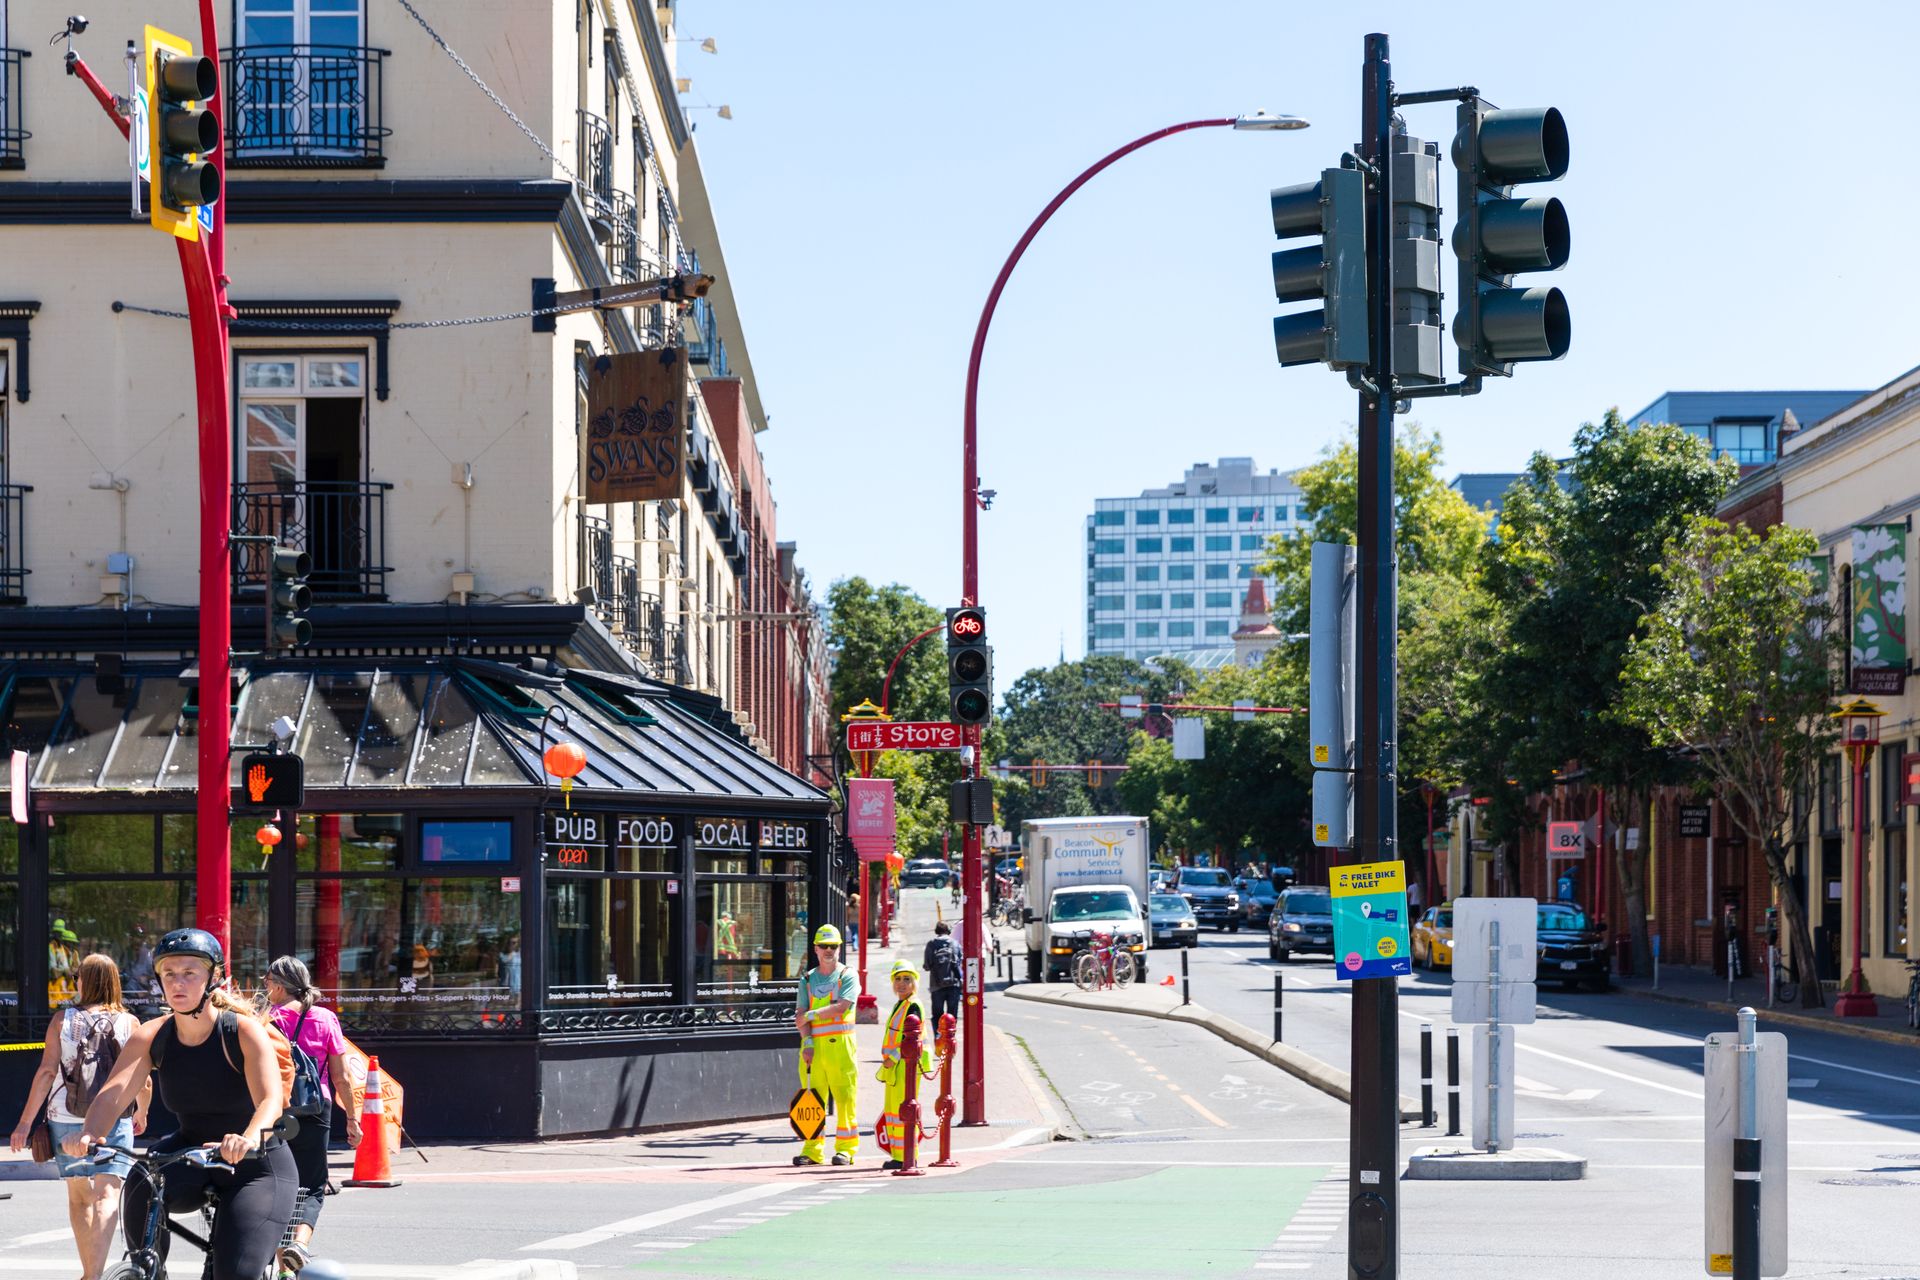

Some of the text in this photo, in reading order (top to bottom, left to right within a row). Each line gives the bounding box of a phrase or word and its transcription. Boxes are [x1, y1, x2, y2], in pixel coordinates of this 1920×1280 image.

[589, 435, 677, 484] SWANS
[1860, 672, 1898, 680] MARKET
[1857, 682, 1898, 690] SQUARE
[890, 725, 956, 742] Store
[1682, 809, 1707, 817] VINTAGE
[555, 817, 597, 840] PUB
[618, 820, 673, 843] FOOD
[762, 825, 807, 848] BEER
[1064, 839, 1095, 847] Beacon
[1560, 834, 1582, 847] 8X
[558, 848, 588, 868] open
[1087, 859, 1120, 867] Services
[1056, 868, 1123, 877] www.beaconcs.ca
[1351, 870, 1396, 881] FREE BIKE
[1351, 880, 1380, 889] VALET
[5, 998, 18, 1006] Tap
[122, 998, 149, 1006] Burgers
[379, 995, 406, 1003] Burgers
[435, 994, 463, 1002] Suppers
[468, 994, 490, 1002] Happy
